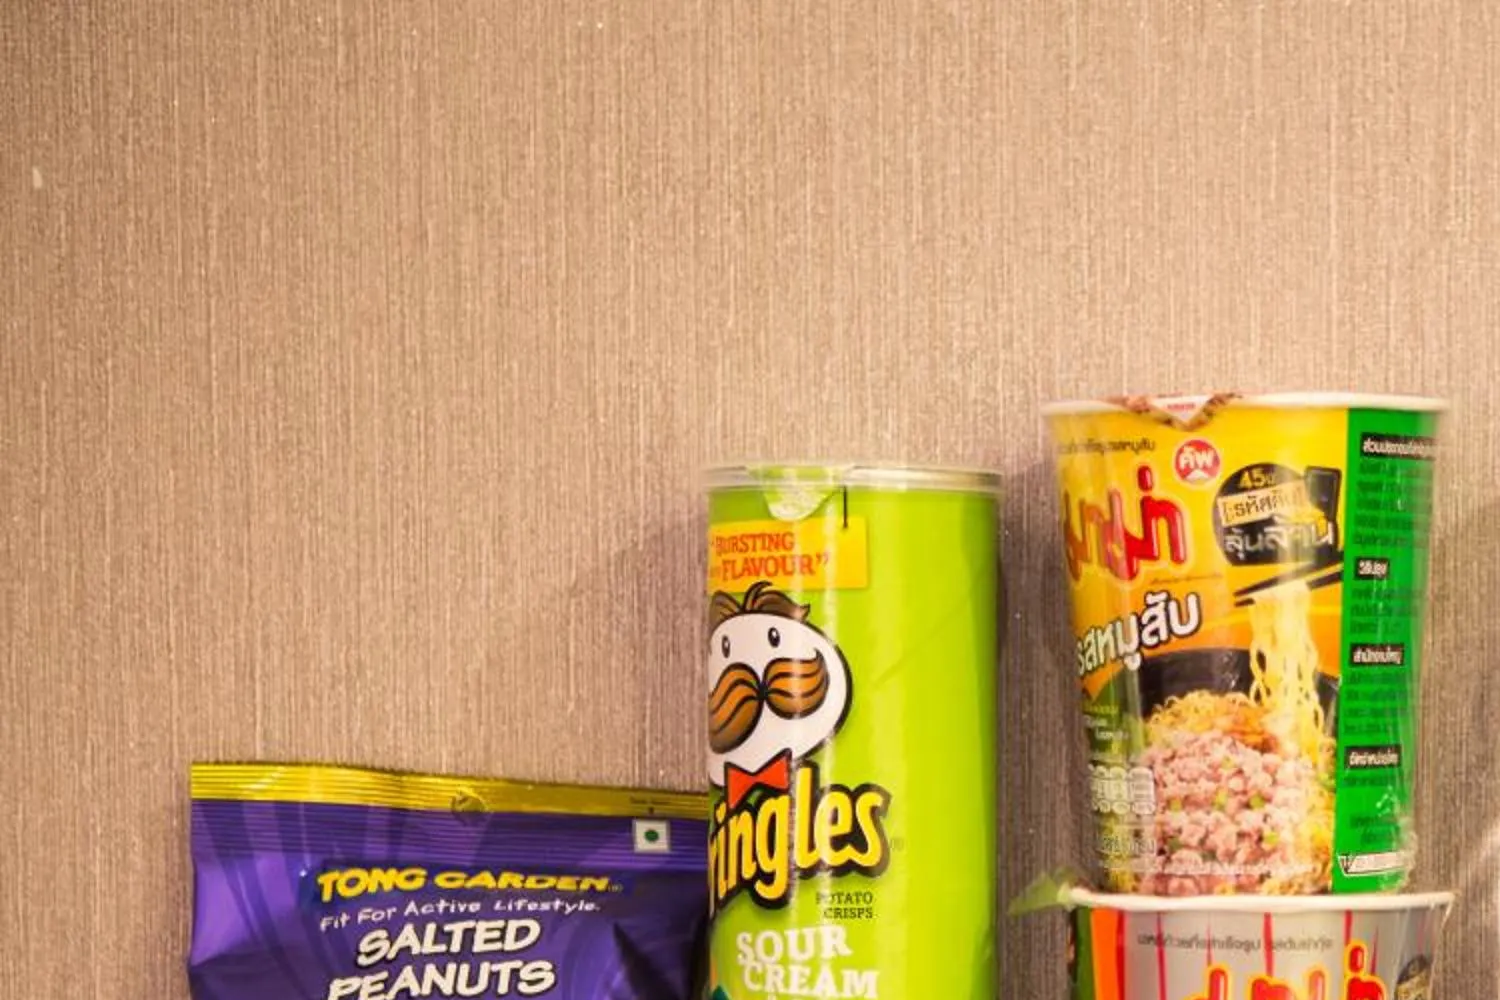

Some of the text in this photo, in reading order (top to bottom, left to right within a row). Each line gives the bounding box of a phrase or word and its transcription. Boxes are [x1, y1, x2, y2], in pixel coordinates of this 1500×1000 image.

[1179, 446, 1216, 466] คัพ
[317, 867, 609, 902] TONG GARDEN
[320, 912, 350, 931] Fit
[357, 906, 397, 924] For
[403, 899, 481, 916] Active
[824, 907, 873, 919] CRISPS
[357, 919, 541, 966] SALTED
[736, 925, 853, 966] SOUR
[743, 961, 879, 999] CREAM
